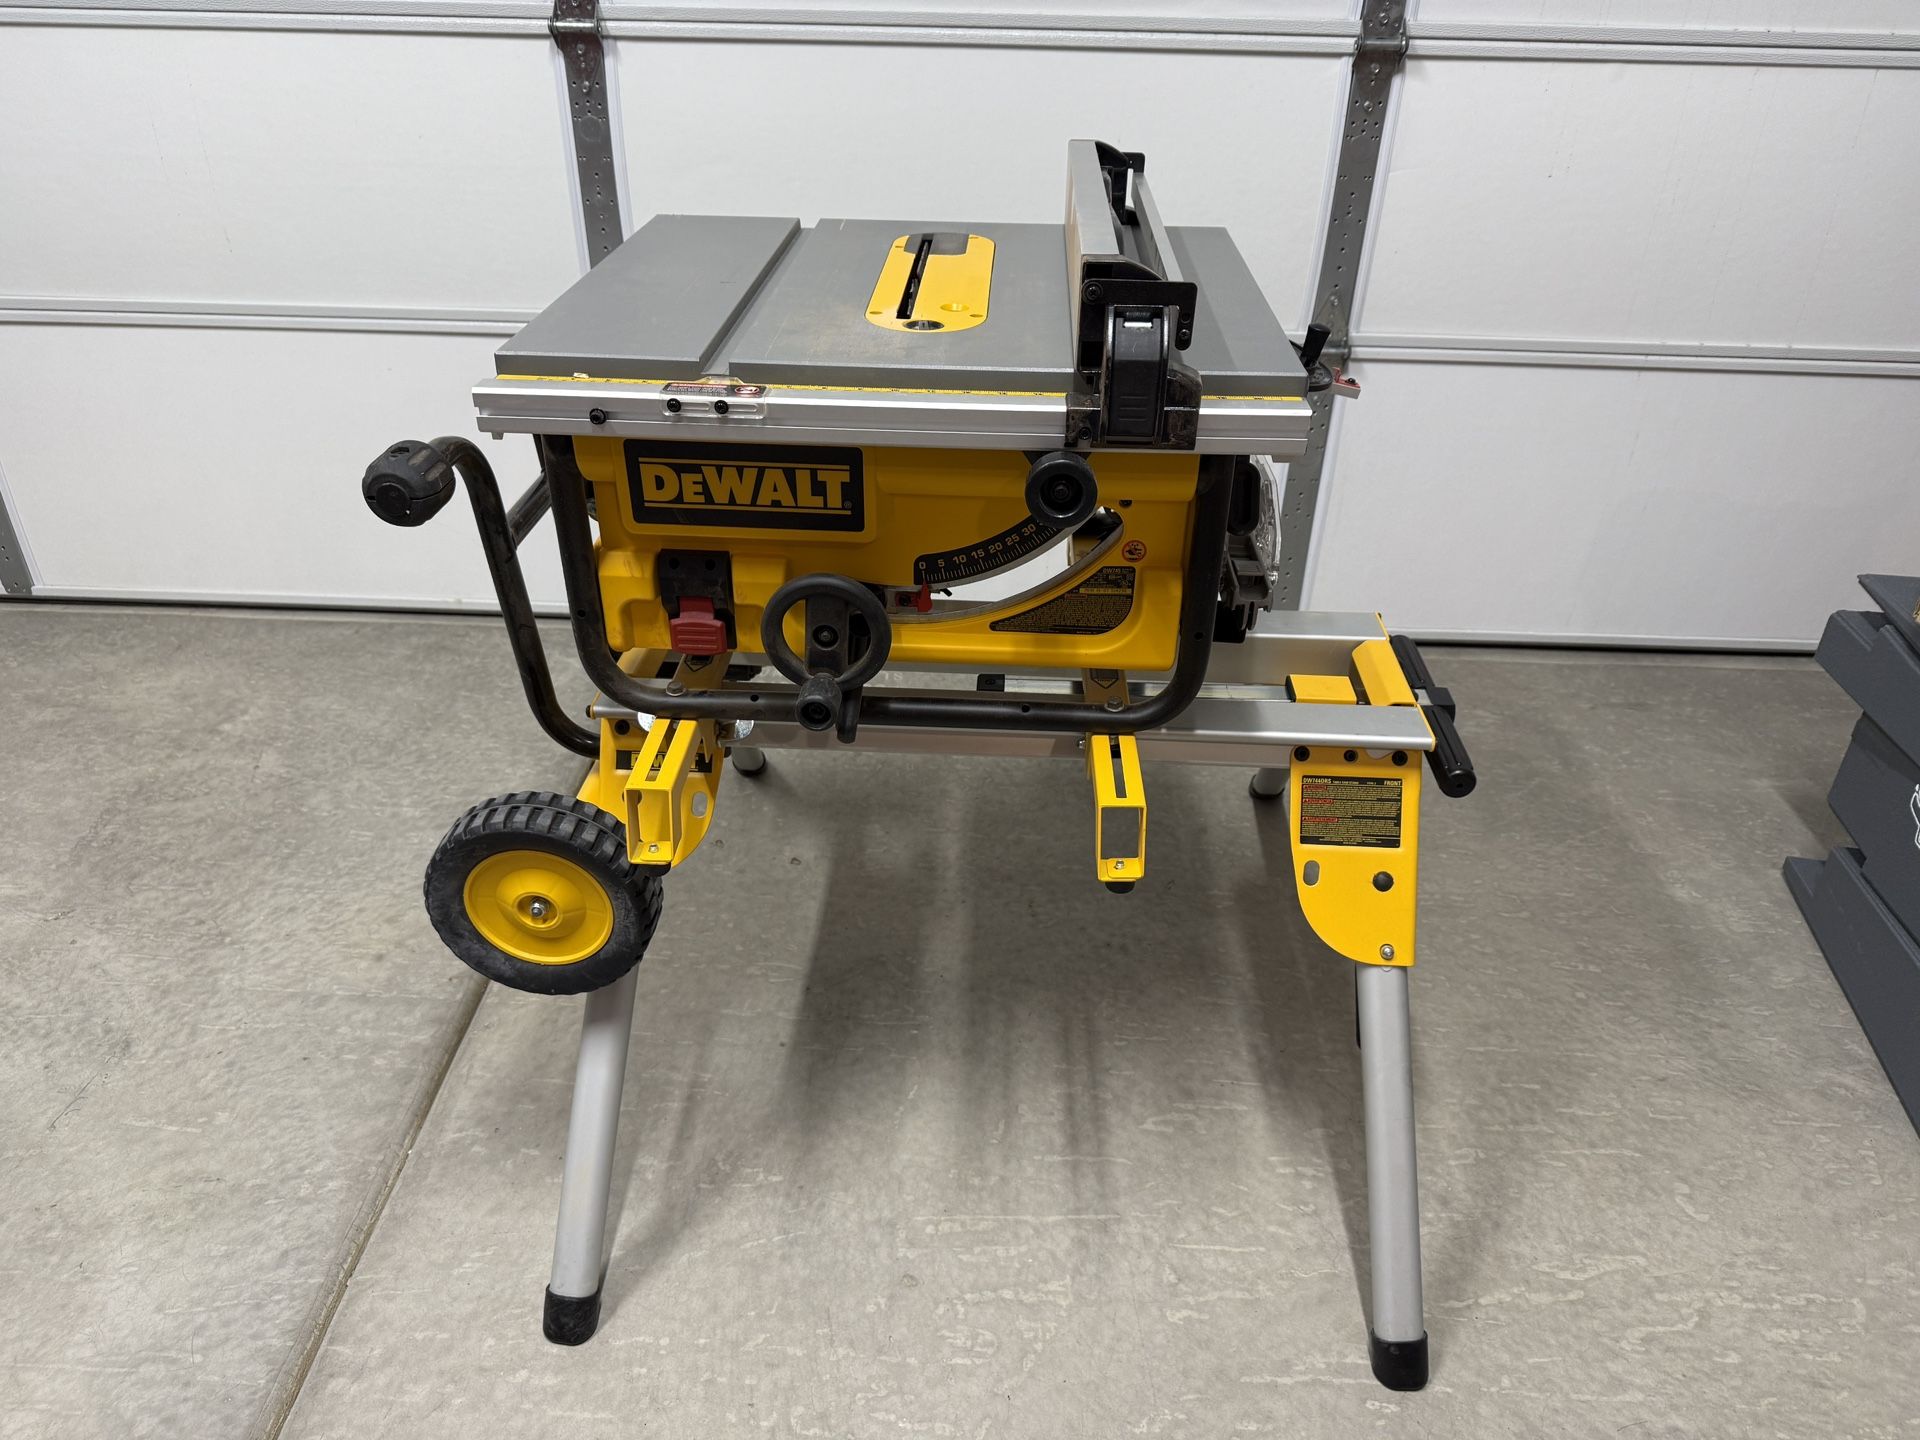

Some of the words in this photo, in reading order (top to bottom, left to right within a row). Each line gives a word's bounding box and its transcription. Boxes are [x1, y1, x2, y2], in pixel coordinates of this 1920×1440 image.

[918, 561, 927, 570] 0
[937, 559, 945, 568] 5
[952, 554, 967, 565] 10
[970, 548, 985, 559] 15
[988, 541, 1003, 553] 20
[1005, 533, 1020, 545] 25
[1020, 523, 1037, 536] 30
